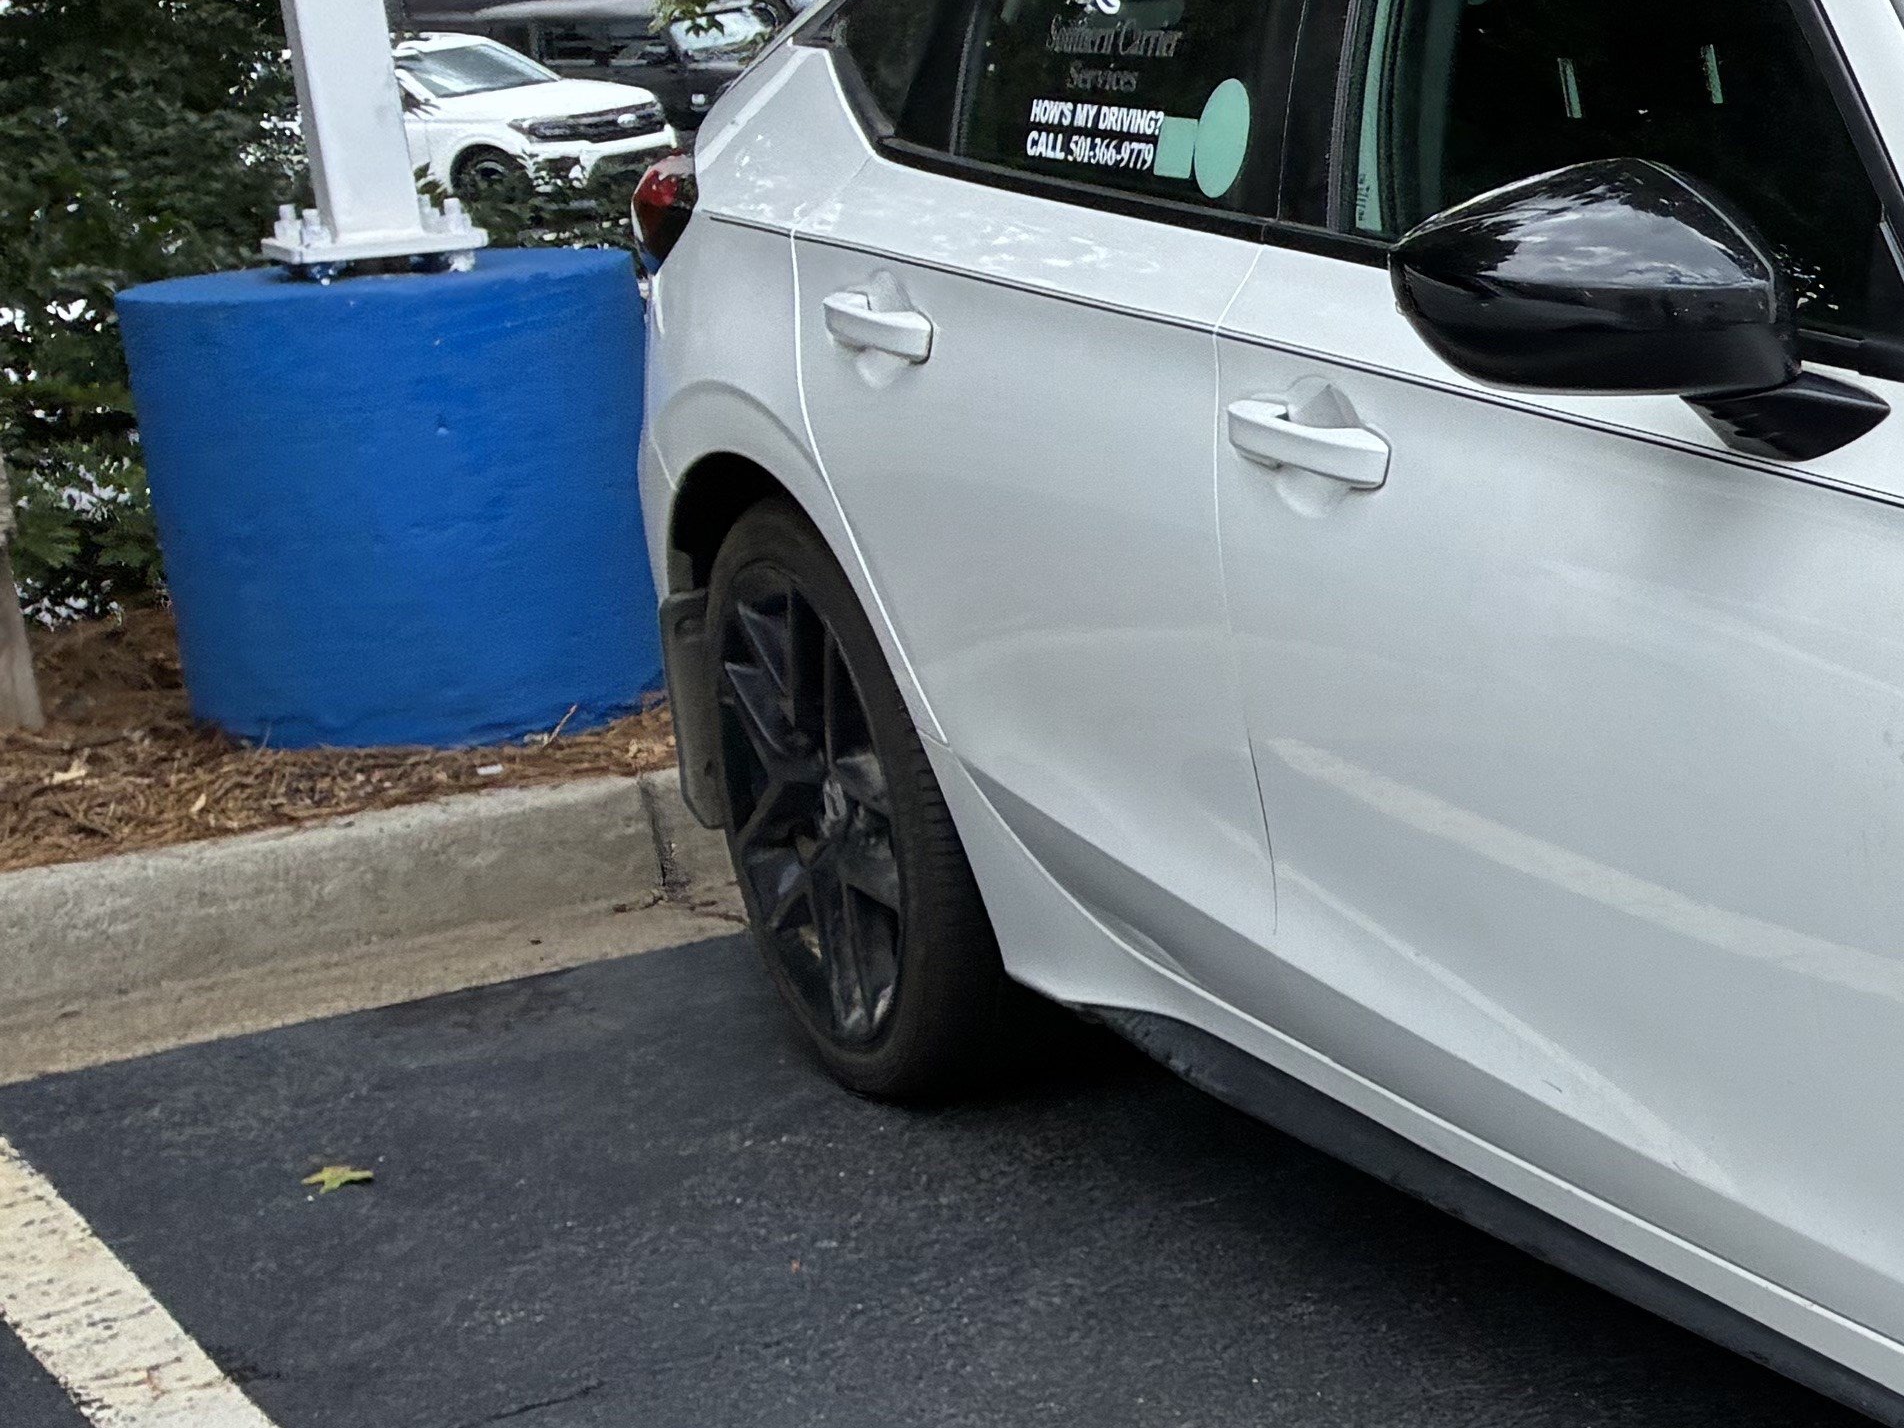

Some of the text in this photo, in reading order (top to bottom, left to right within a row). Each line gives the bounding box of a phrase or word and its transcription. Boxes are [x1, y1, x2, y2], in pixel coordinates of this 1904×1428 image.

[1118, 20, 1183, 58] Carrier
[1065, 60, 1139, 92] Services
[1029, 98, 1165, 136] HOW'S MY DRIVING?
[1026, 130, 1155, 171] CALL 501-366-9779
